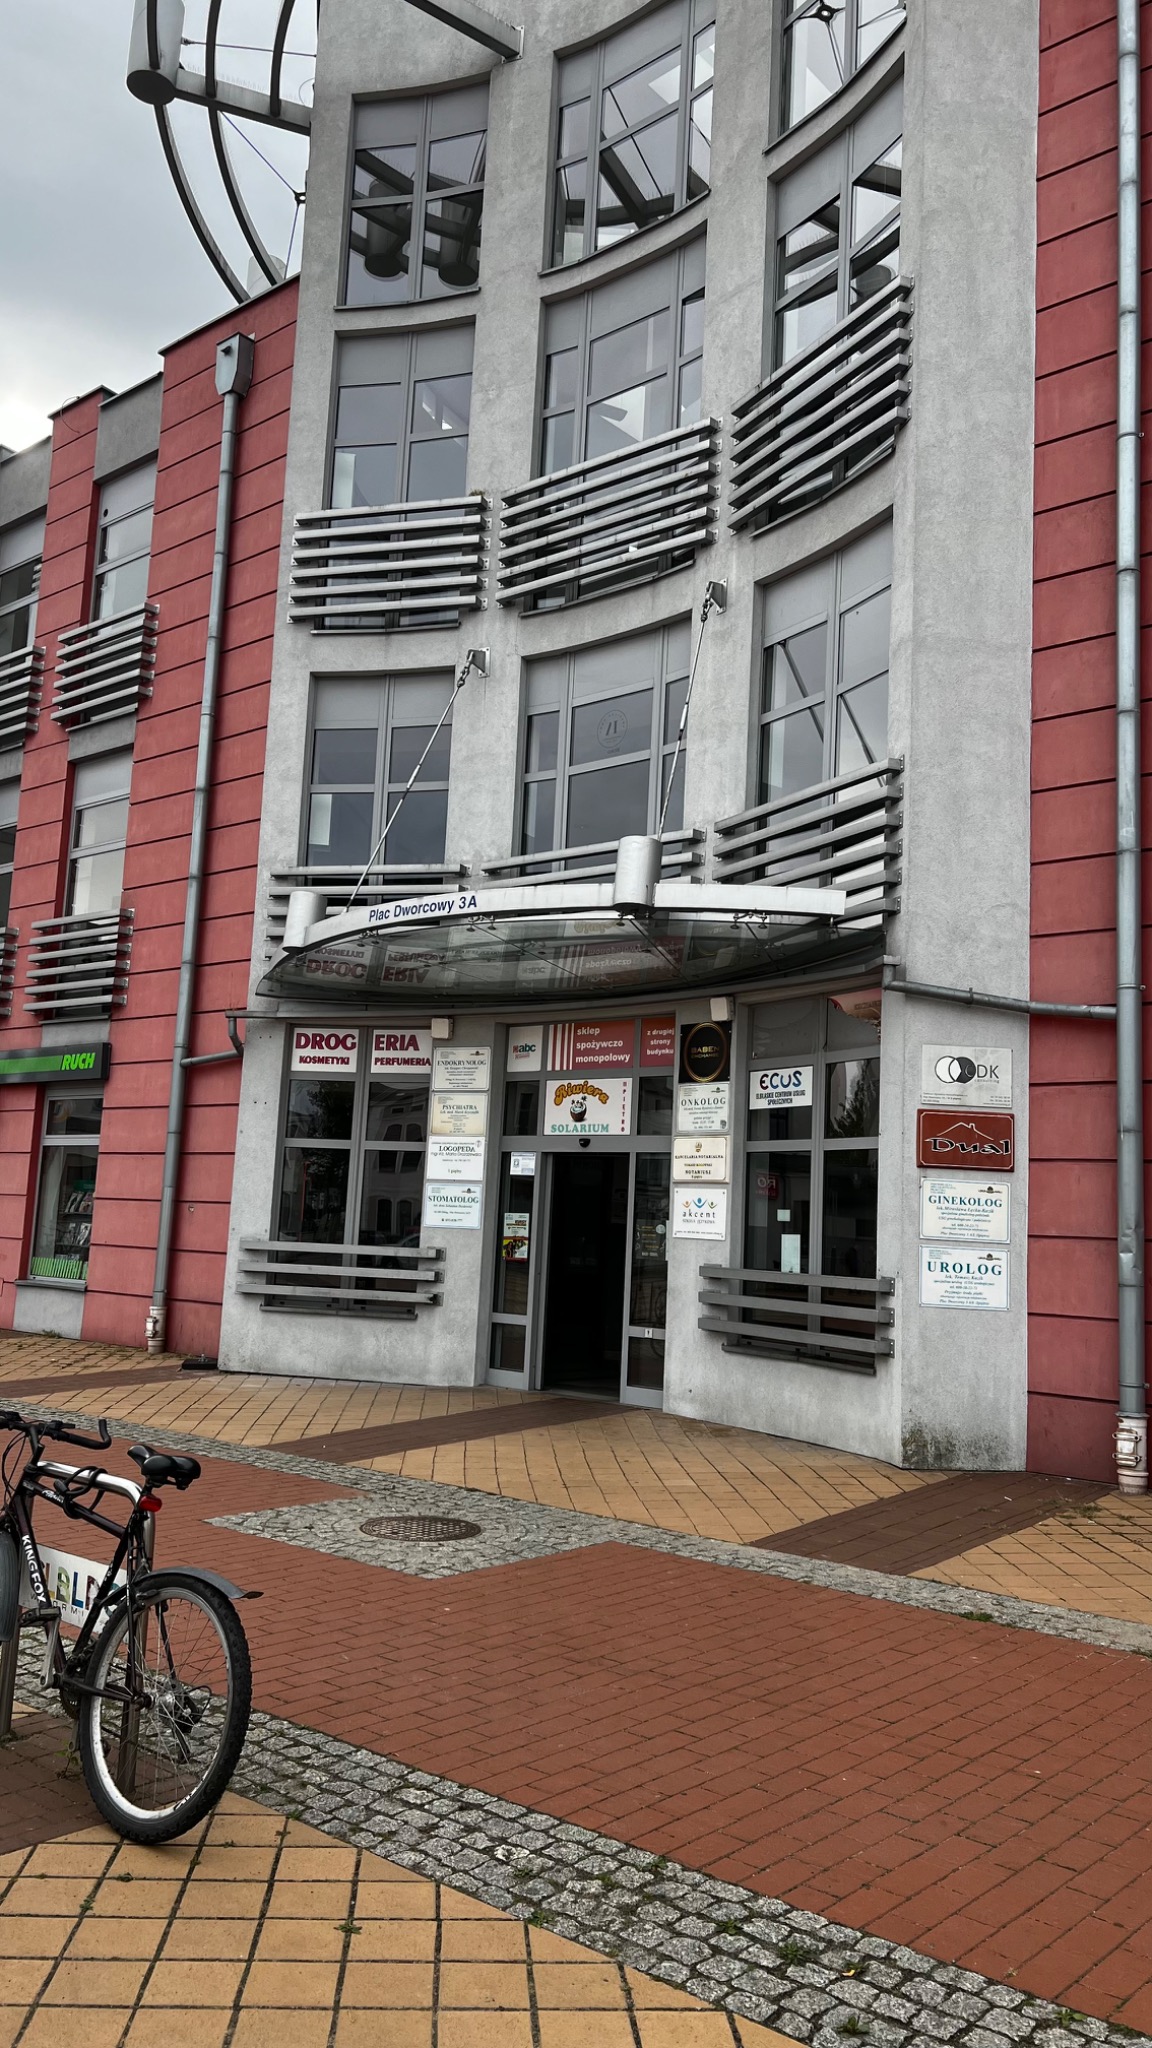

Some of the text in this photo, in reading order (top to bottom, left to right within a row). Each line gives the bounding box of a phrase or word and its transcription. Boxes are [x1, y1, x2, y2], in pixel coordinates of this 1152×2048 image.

[369, 908, 391, 922] Plac
[393, 900, 455, 918] Dworcowy
[576, 1026, 601, 1036] sklep
[652, 1027, 675, 1036] drugiej
[295, 1032, 357, 1051] DROG
[374, 1034, 420, 1051] ERIA
[576, 1040, 624, 1051] spożywczo
[650, 1038, 671, 1046] strony
[518, 1043, 536, 1053] abc
[646, 1048, 674, 1056] budynku
[61, 1052, 96, 1071] RUCH
[298, 1055, 350, 1066] KOSMETYKI
[374, 1057, 432, 1066] PERFUMERIA
[575, 1052, 631, 1064] monopolowy
[759, 1070, 802, 1091] ECUS
[553, 1080, 610, 1106] Riwiera
[774, 1090, 793, 1098] CENTRUM
[681, 1096, 726, 1107] ONKOLOG
[550, 1123, 610, 1133] SOLARIUM
[438, 1145, 476, 1153] LOGOPEDA
[924, 1137, 1011, 1156] Dual
[428, 1195, 479, 1204] STOMATOLOG
[928, 1194, 1003, 1208] GINEKOLOG
[682, 1209, 716, 1219] akcent
[927, 1261, 1002, 1276] UROLOG
[21, 1534, 47, 1603] KINGFOX
